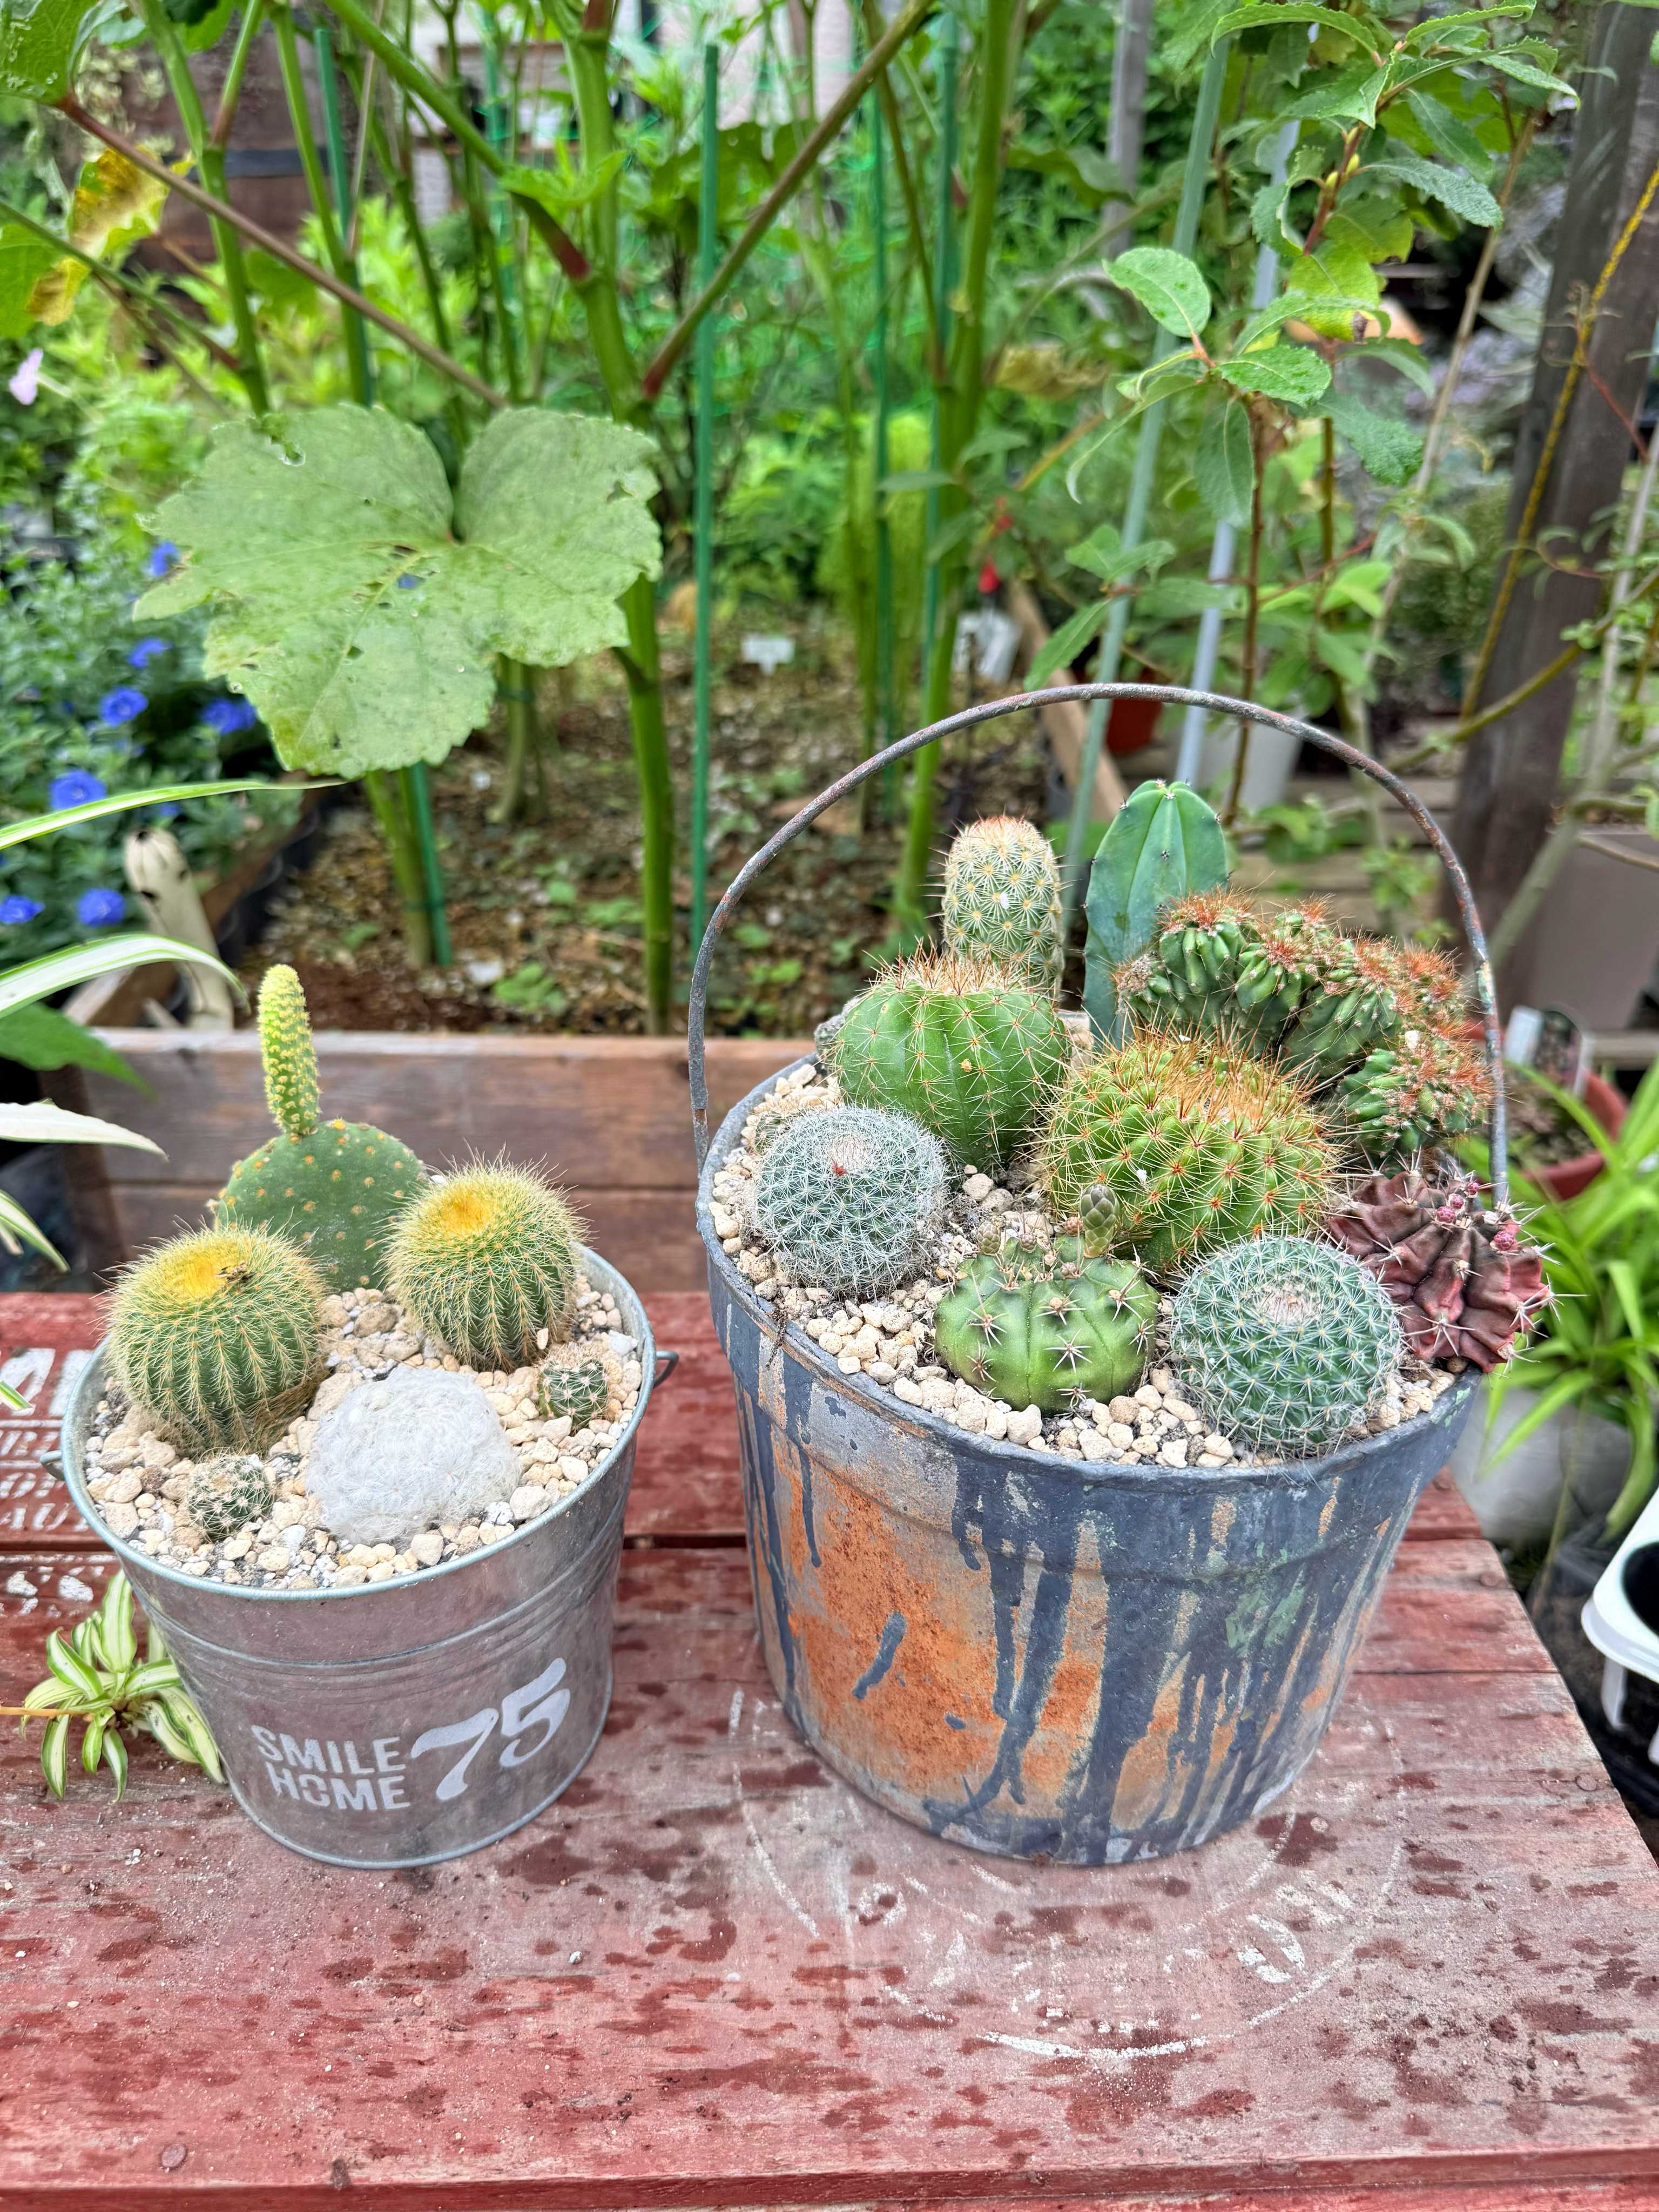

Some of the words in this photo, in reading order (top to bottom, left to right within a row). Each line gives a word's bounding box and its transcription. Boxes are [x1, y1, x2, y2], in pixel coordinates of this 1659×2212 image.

[251, 1725, 407, 1775] SMILE
[410, 1657, 571, 1800] 75
[266, 1762, 411, 1811] HOME
